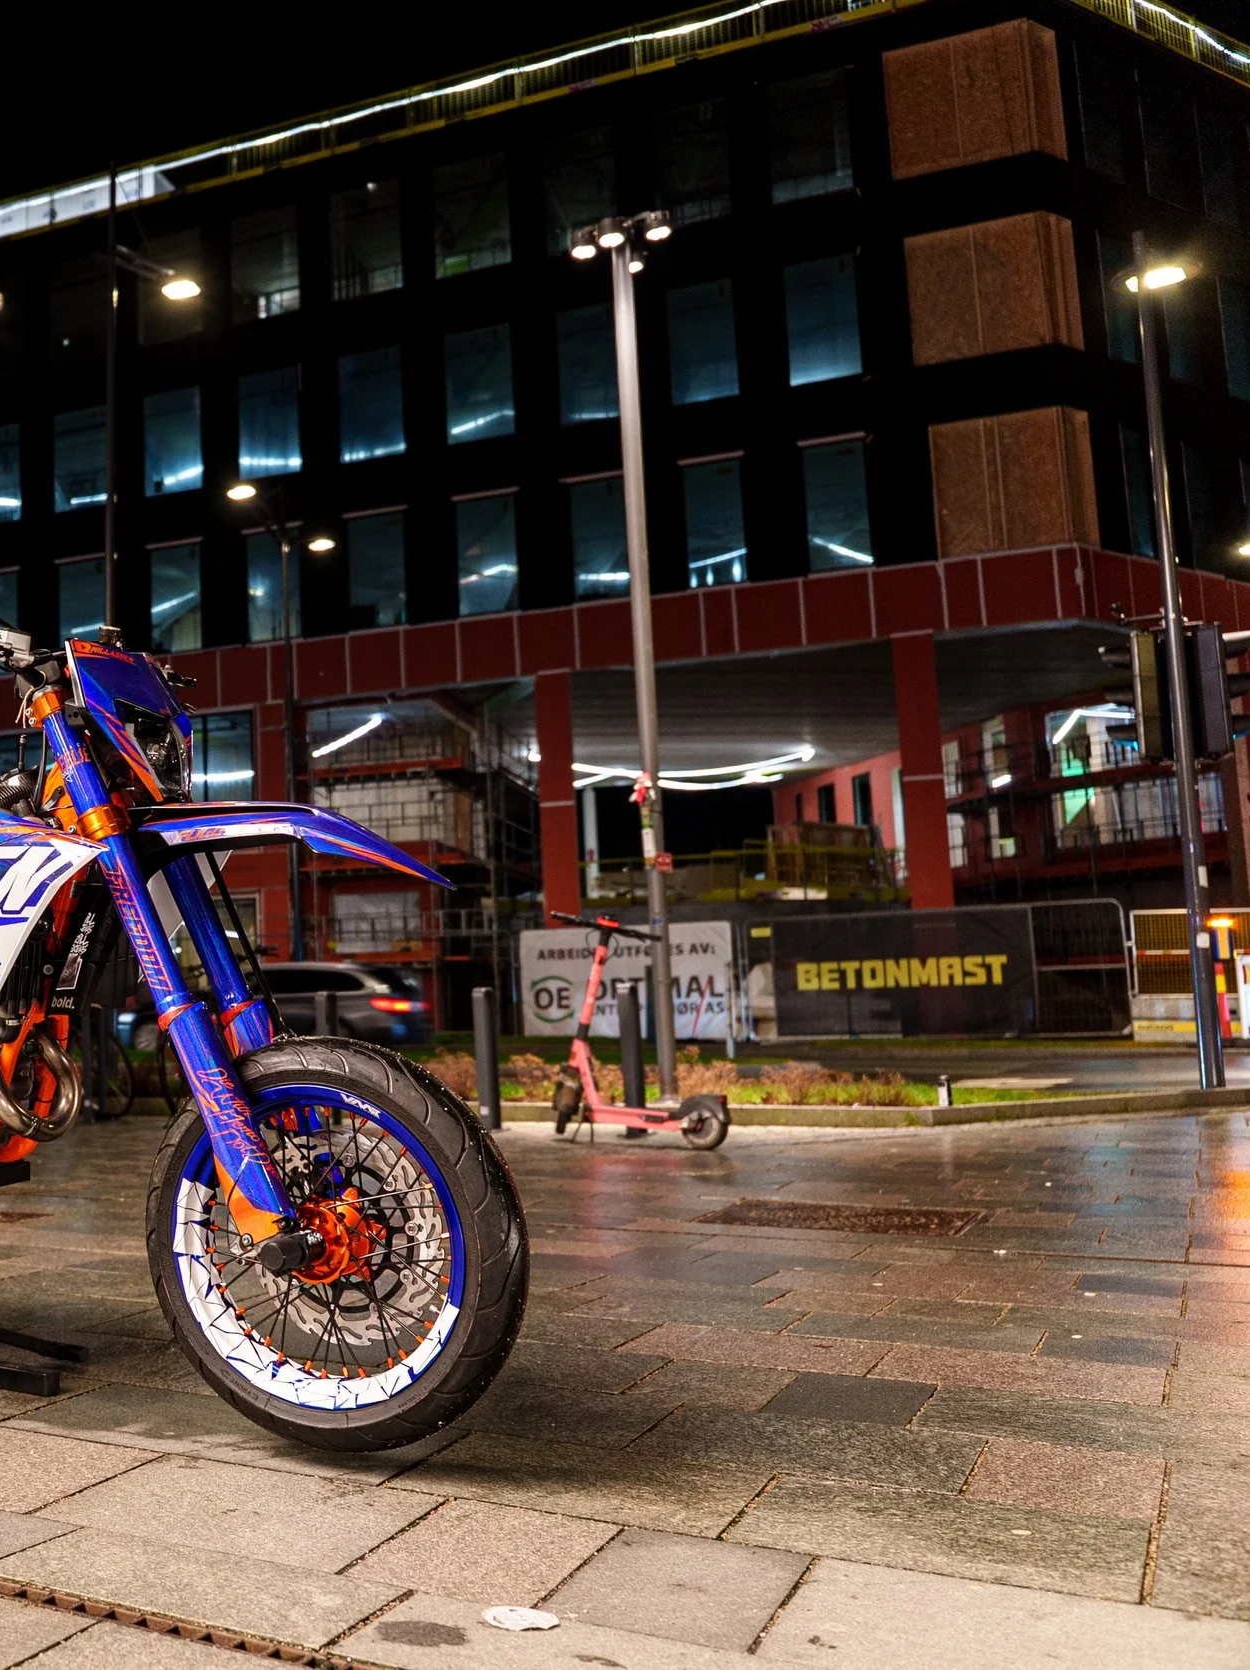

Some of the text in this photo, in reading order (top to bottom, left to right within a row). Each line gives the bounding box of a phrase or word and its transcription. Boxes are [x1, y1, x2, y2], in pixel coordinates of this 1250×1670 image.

[537, 947, 598, 961] ARBEID
[613, 943, 684, 957] UTFØS
[797, 954, 1007, 991] BETONMAST
[51, 996, 75, 1009] bold.
[533, 987, 570, 1010] OE
